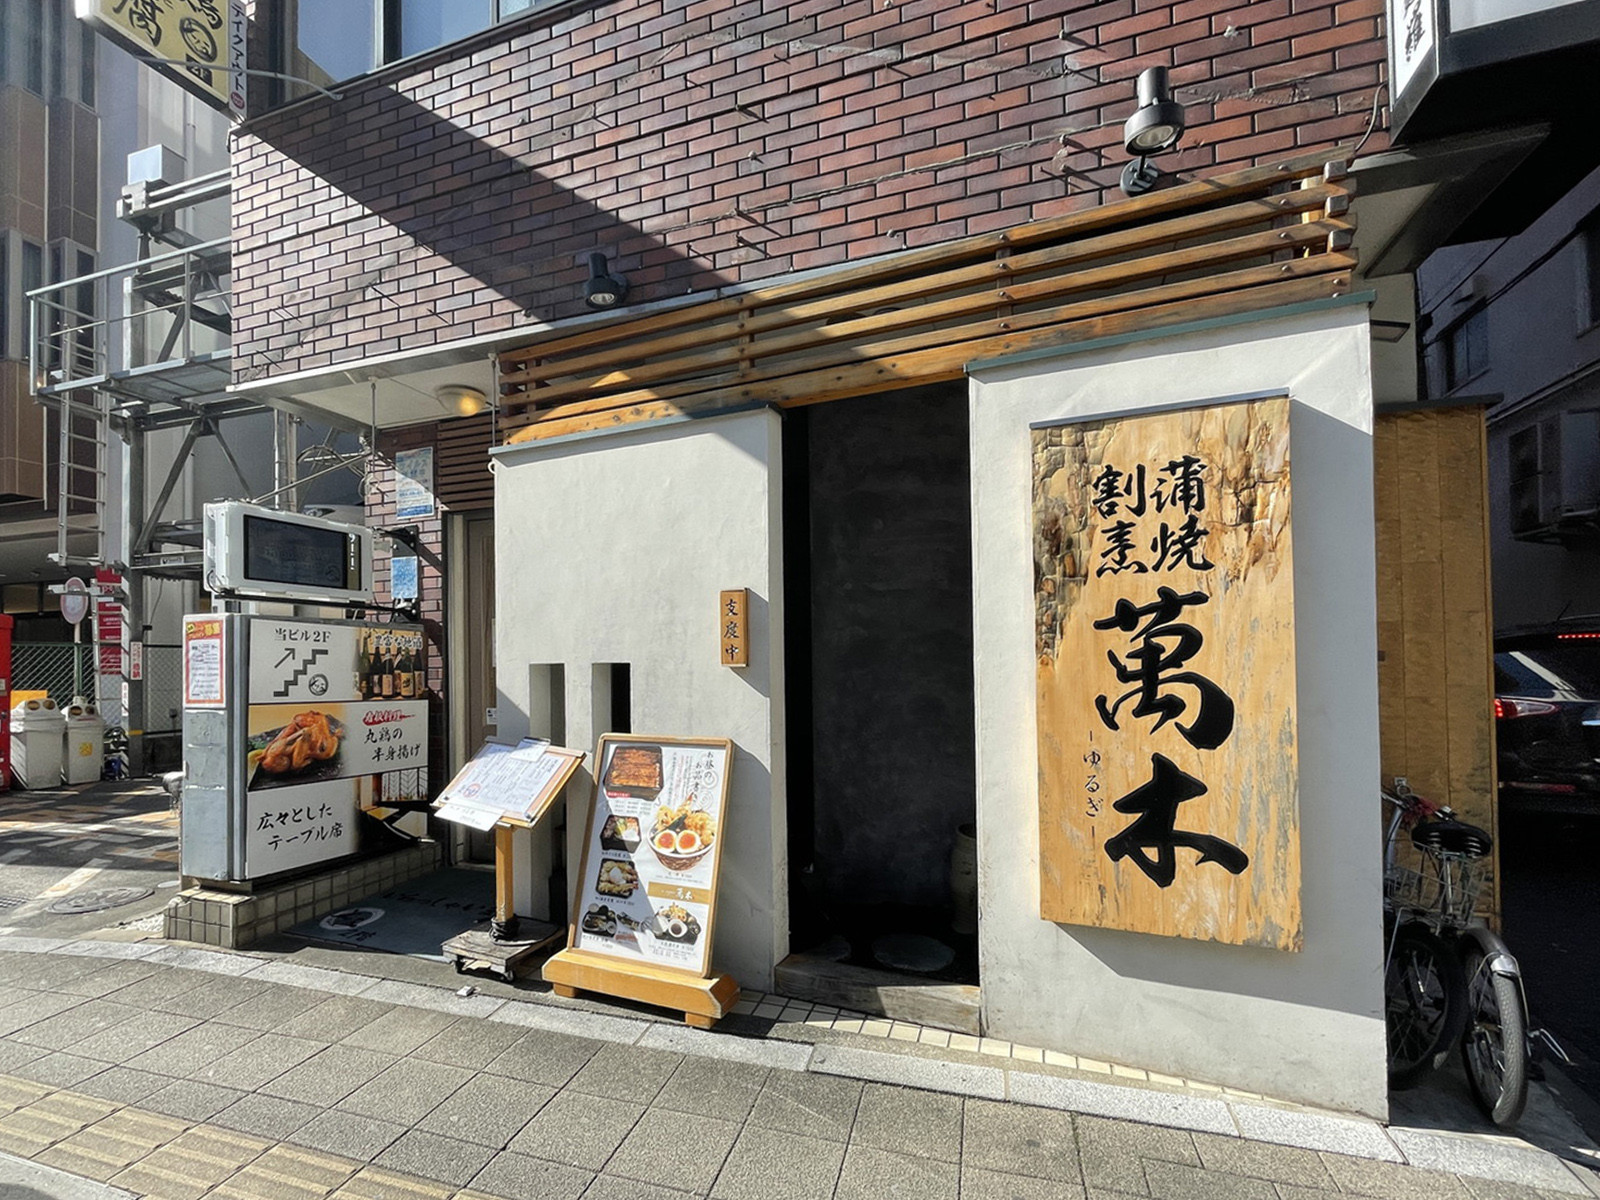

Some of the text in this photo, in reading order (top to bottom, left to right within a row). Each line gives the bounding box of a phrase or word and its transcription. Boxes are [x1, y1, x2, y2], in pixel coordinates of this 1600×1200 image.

[231, 3, 245, 91] テイクアウト
[1092, 464, 1149, 578] 割烹
[1150, 455, 1215, 572] 蒲焼
[274, 627, 332, 643] 当ビル2F
[724, 599, 740, 661] 支度中
[364, 728, 403, 744] 丸鶏の
[372, 743, 421, 762] 半身揚げ
[1093, 586, 1249, 888] 萬木
[256, 803, 333, 832] 広々とした
[268, 822, 344, 852] テーブル席
